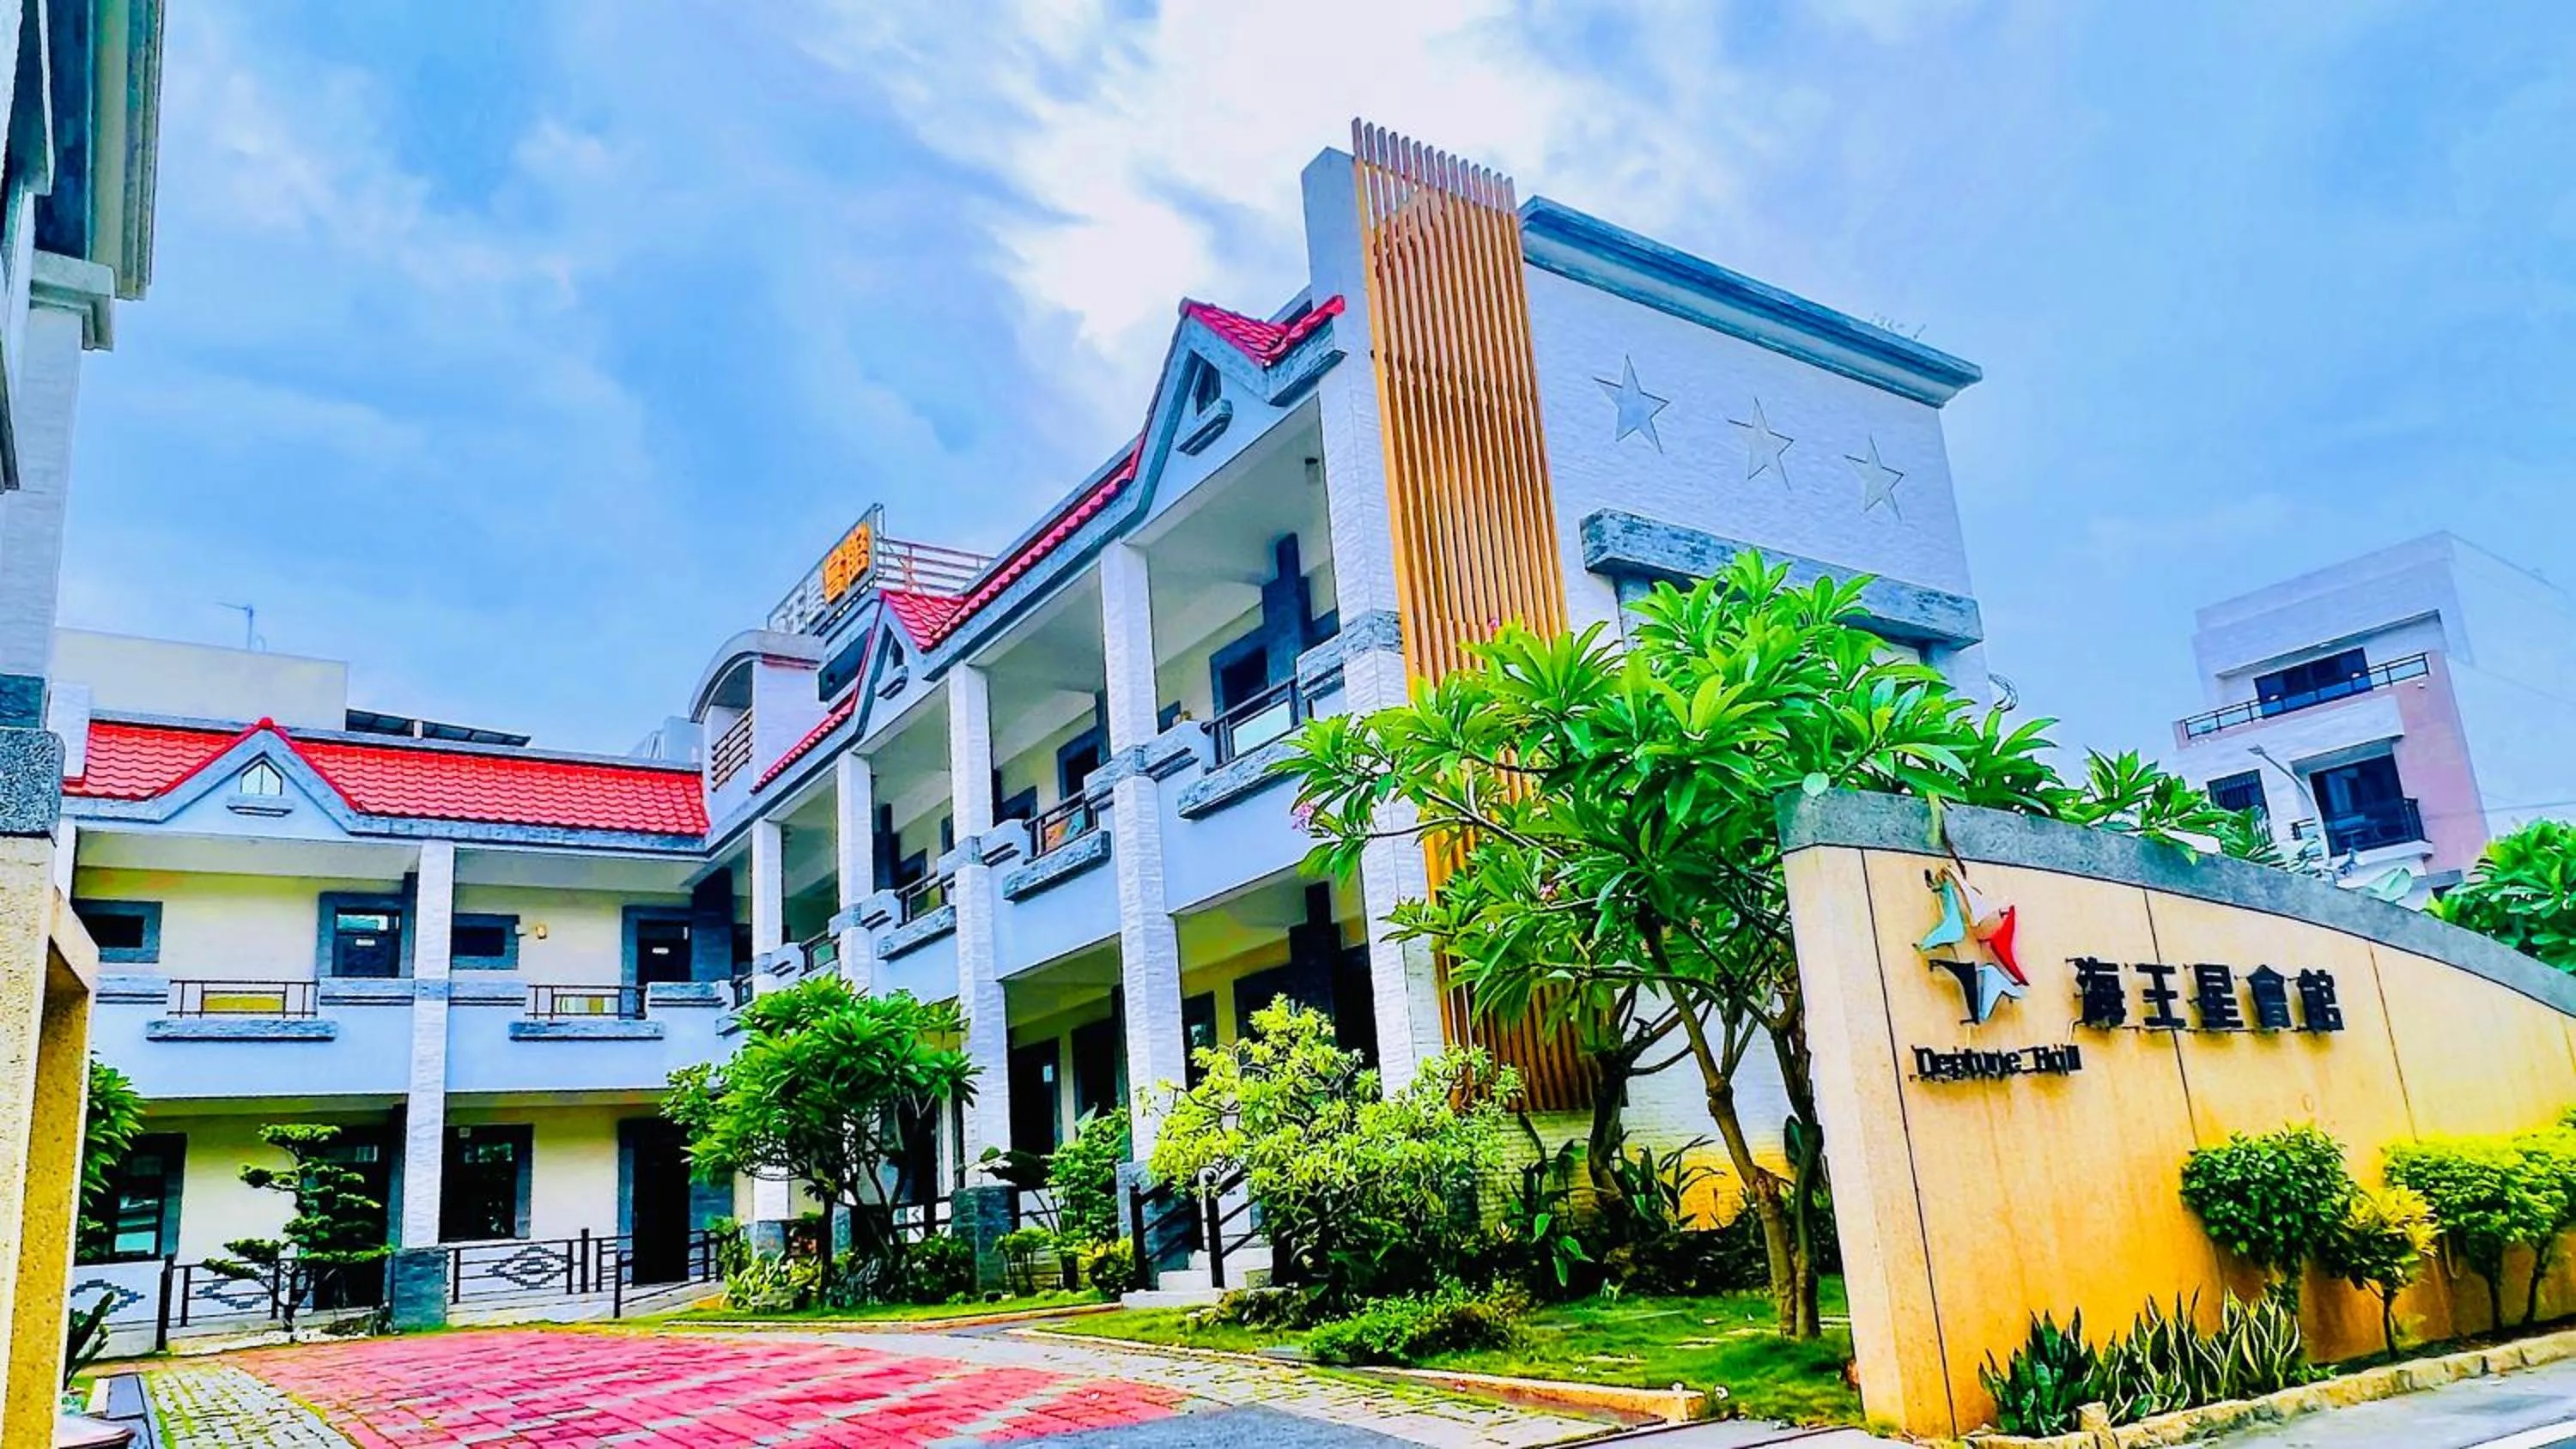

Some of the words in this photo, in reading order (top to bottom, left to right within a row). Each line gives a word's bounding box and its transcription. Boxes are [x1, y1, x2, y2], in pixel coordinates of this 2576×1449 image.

[2072, 956, 2344, 1031] 海王星會館
